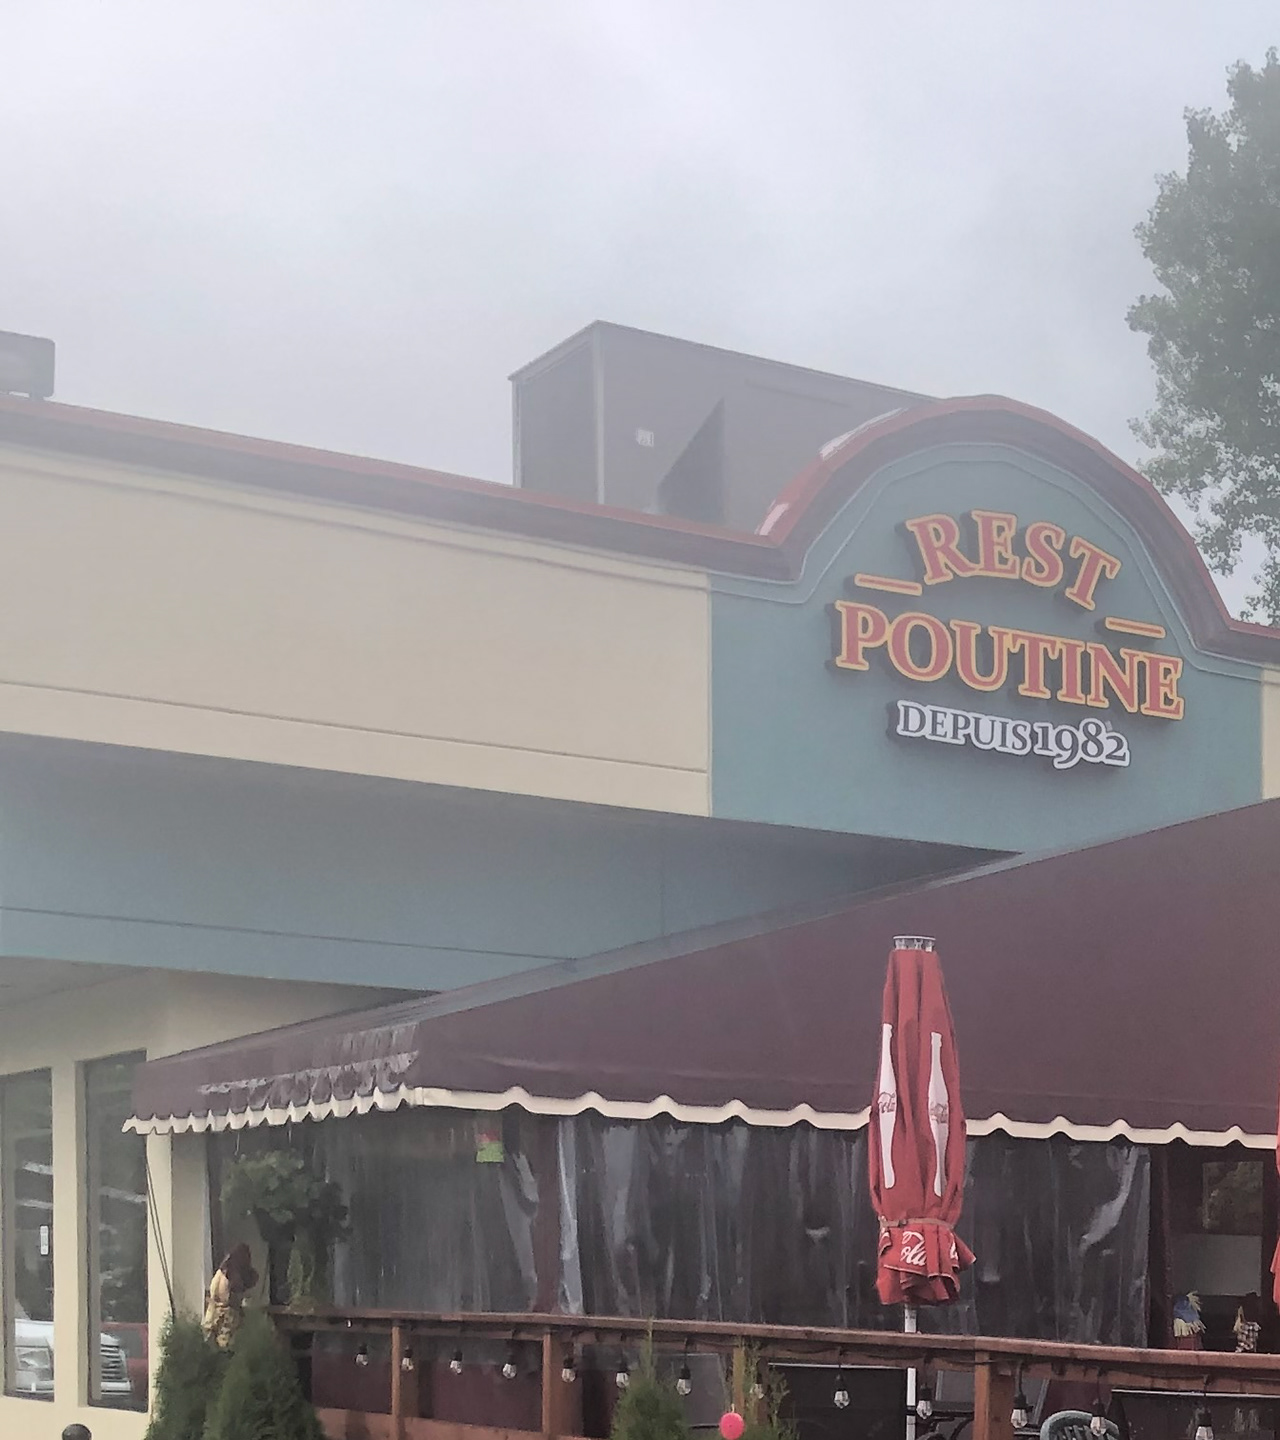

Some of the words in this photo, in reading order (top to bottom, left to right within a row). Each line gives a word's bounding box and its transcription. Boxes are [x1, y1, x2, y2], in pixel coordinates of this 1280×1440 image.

[906, 509, 1122, 611] REST
[835, 600, 1185, 720] POUTINE
[897, 700, 1031, 756] DEPUIS
[1032, 717, 1131, 770] 1982
